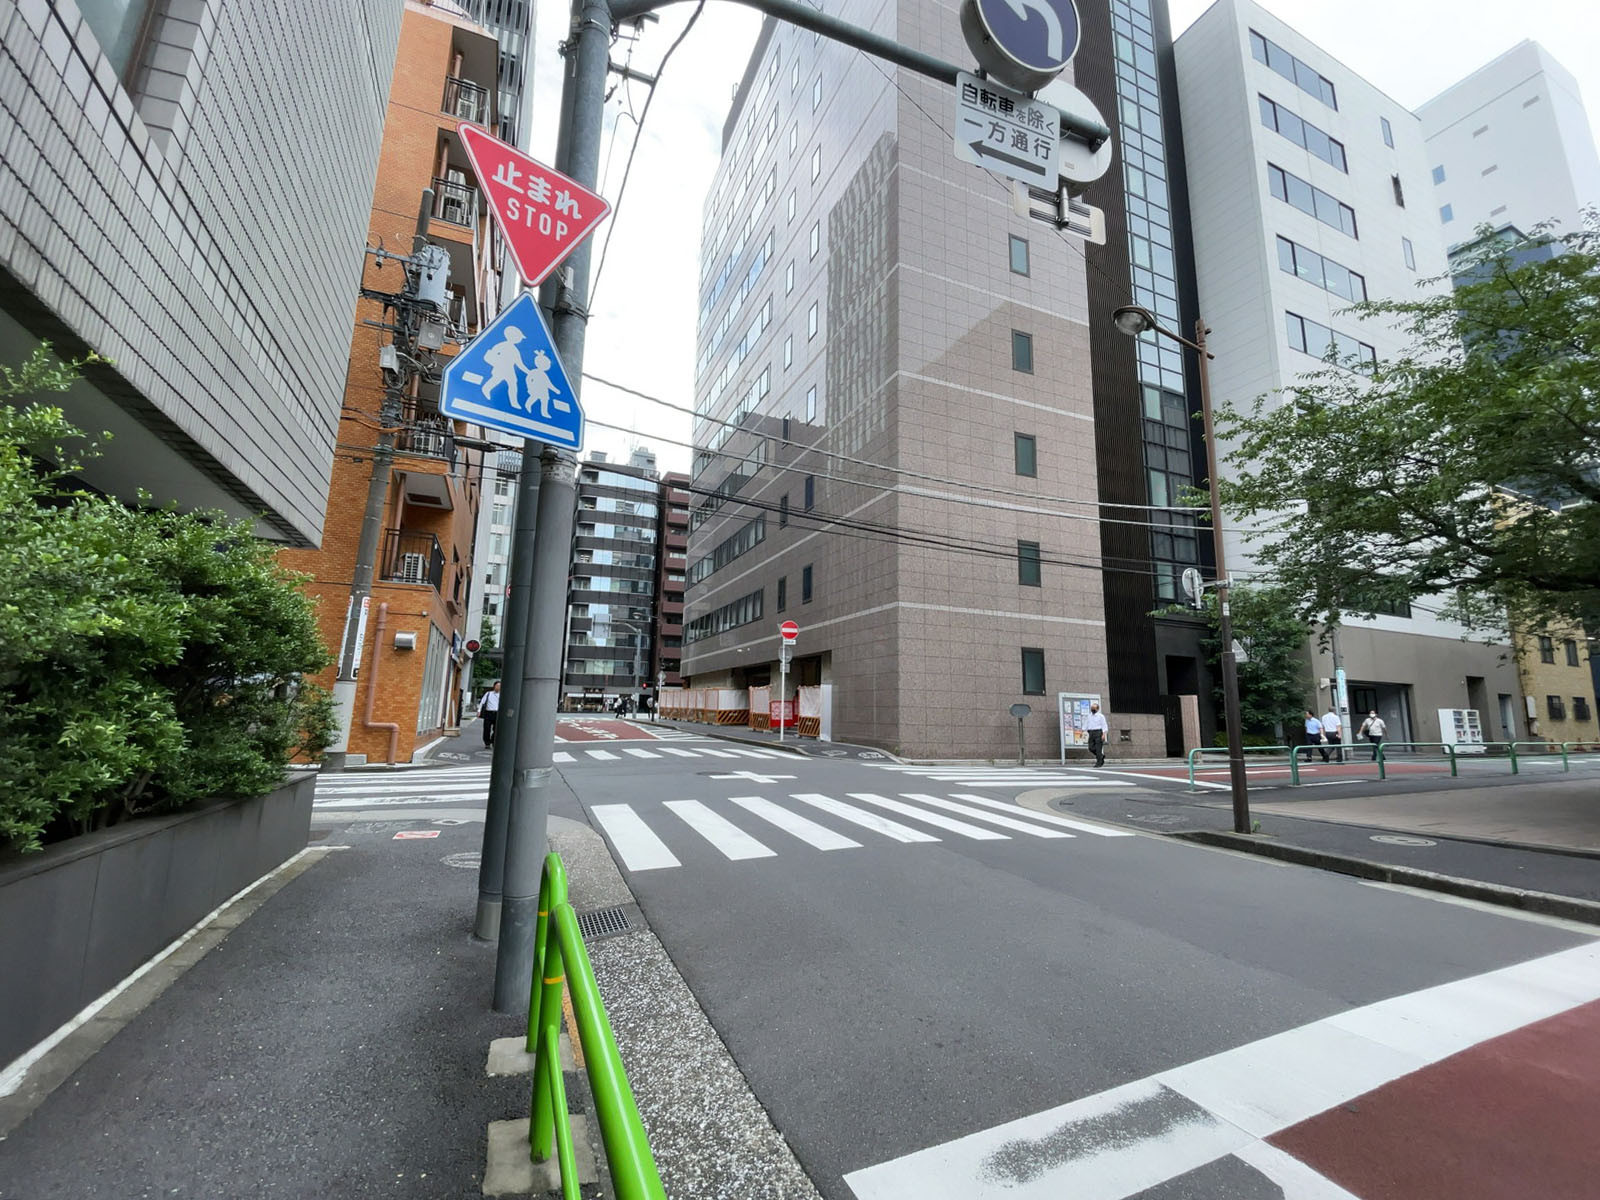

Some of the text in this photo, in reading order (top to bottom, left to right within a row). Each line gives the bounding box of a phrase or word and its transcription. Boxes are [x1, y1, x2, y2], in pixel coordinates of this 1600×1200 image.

[961, 82, 1055, 136] 自転車を除く
[963, 118, 1053, 160] 一方通行
[491, 161, 583, 220] 止まれ
[506, 197, 569, 241] STOP
